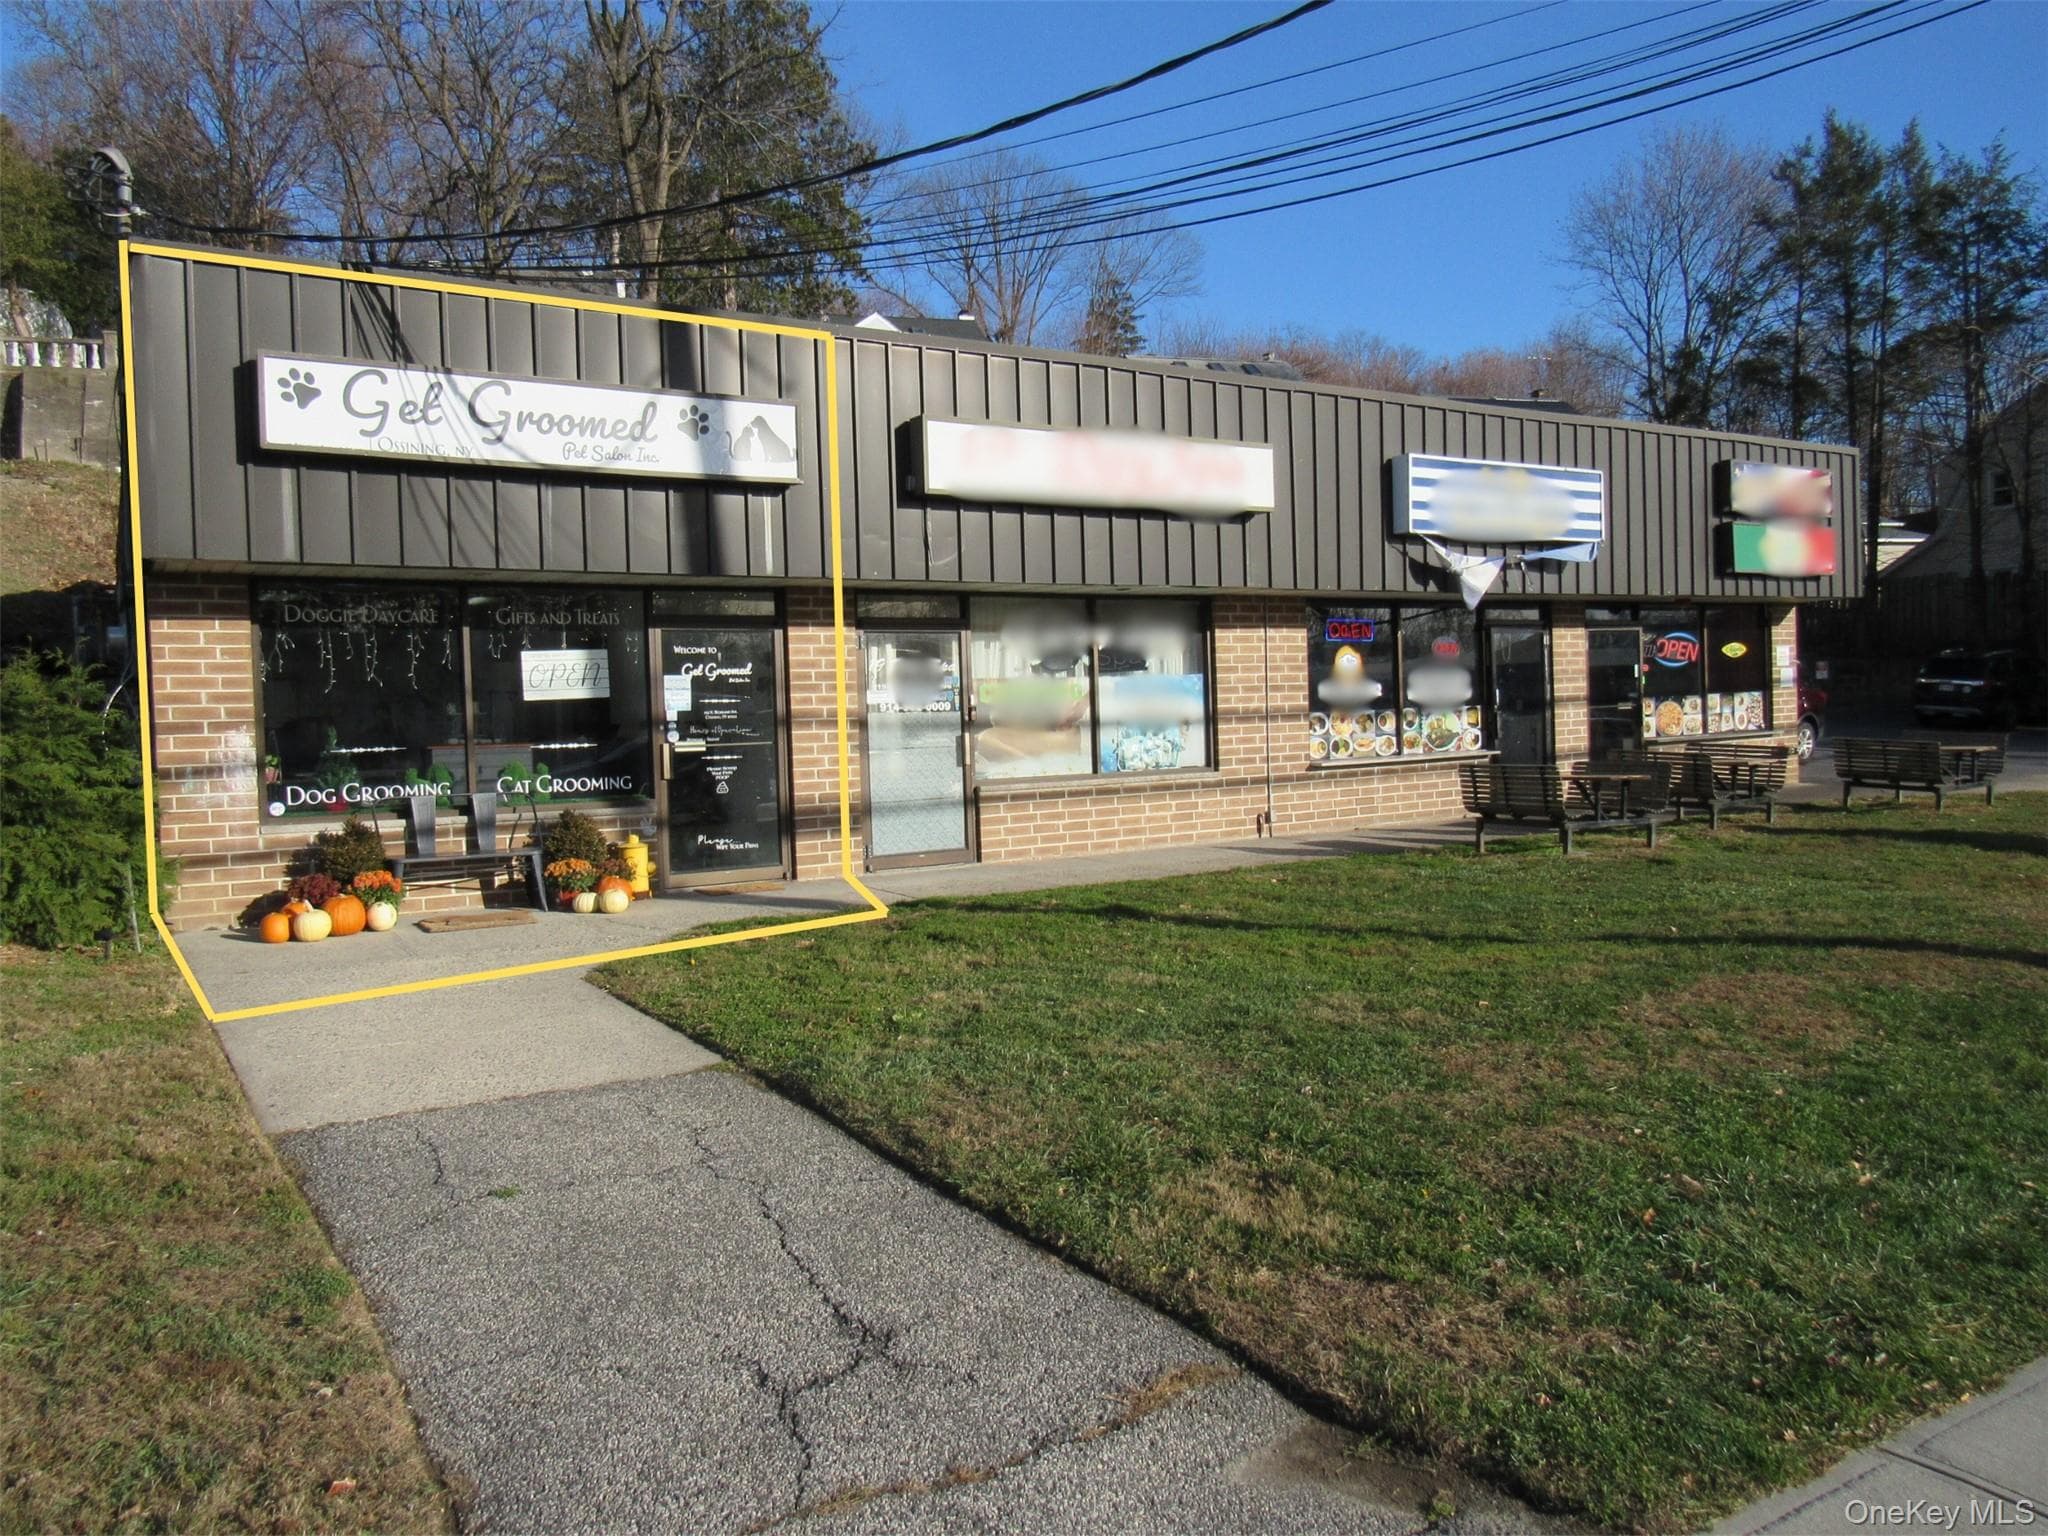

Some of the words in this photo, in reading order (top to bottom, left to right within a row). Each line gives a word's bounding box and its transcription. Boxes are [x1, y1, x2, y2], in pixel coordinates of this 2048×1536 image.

[343, 368, 443, 438] Get
[468, 380, 659, 446] Groomed
[562, 441, 588, 461] Pet
[591, 444, 633, 463] Salon
[635, 446, 660, 463] Inc.
[1656, 638, 1700, 662] OPEN
[705, 662, 753, 682] Groomed
